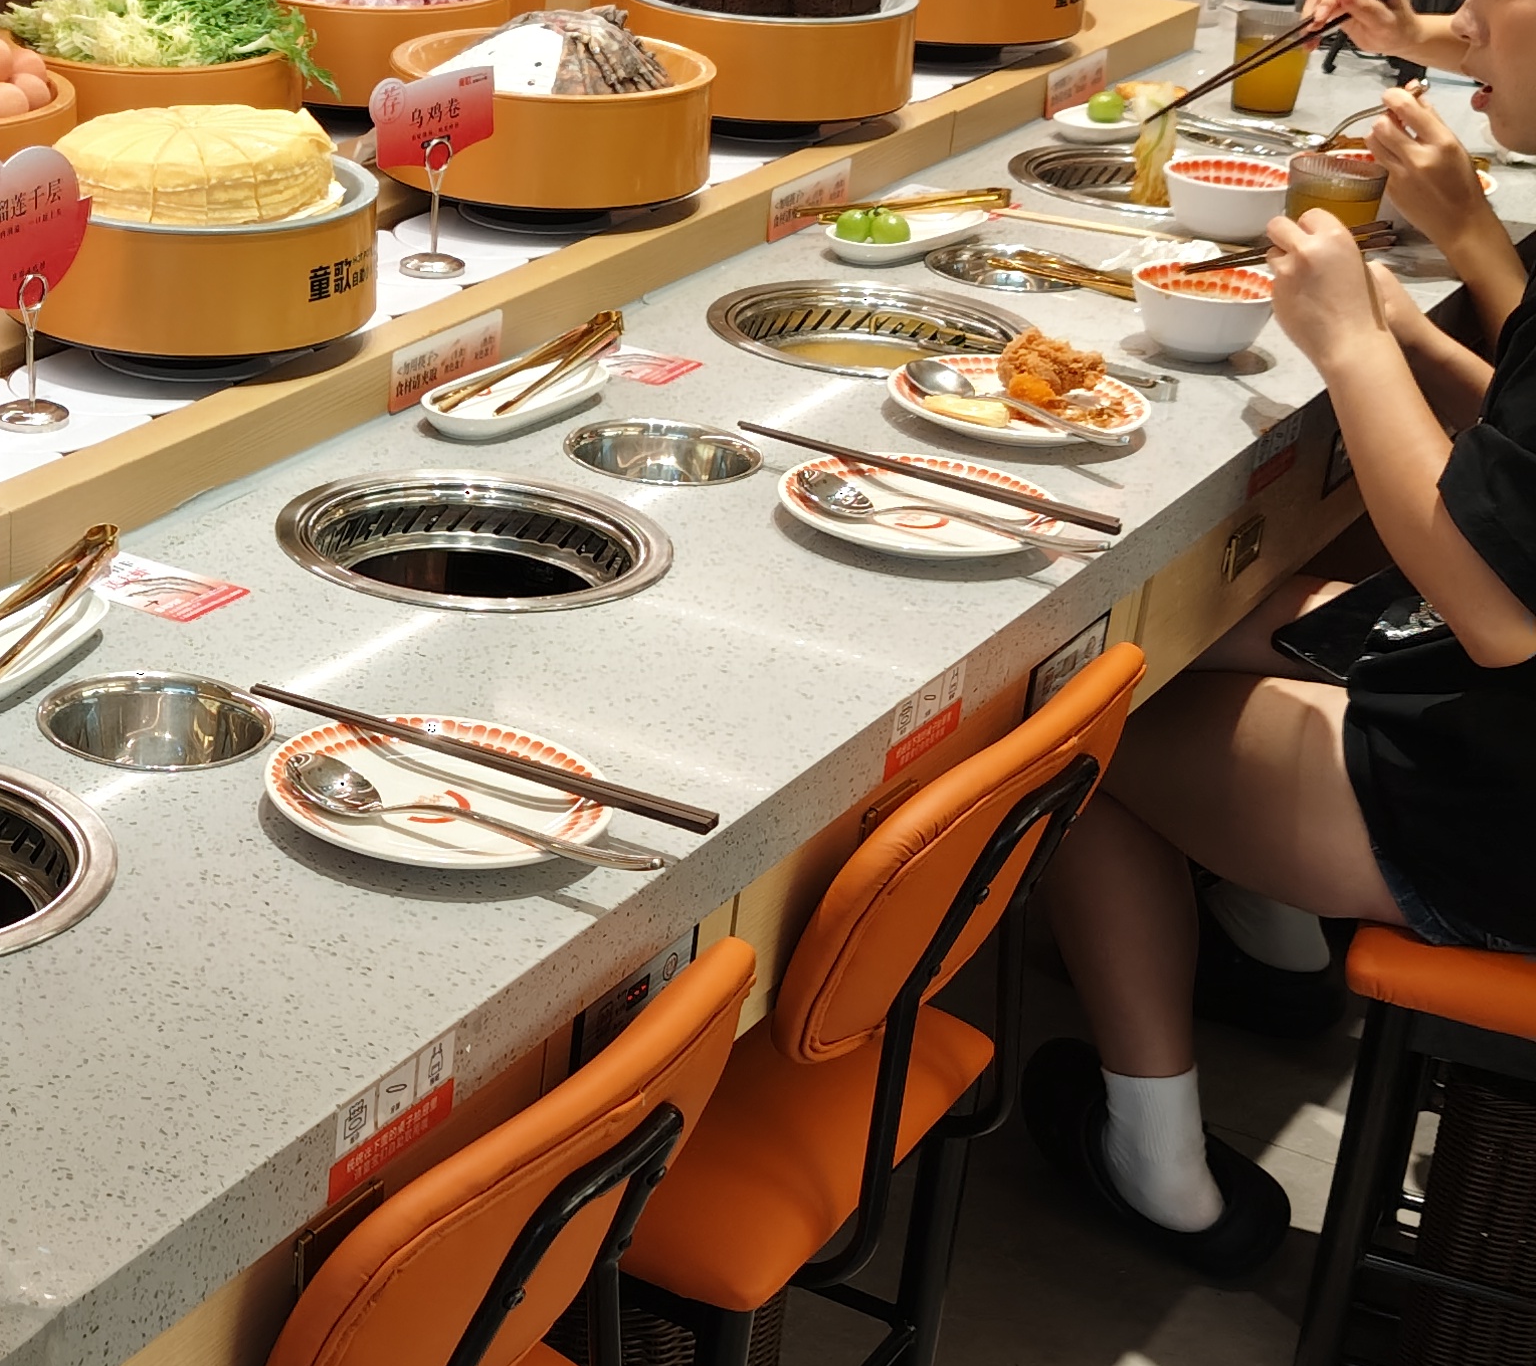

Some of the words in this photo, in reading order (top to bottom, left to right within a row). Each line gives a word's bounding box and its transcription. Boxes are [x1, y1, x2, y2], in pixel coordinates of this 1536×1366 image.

[378, 85, 402, 117] 荐
[409, 97, 462, 130] 乌鸡卷
[308, 258, 352, 303] 童歌
